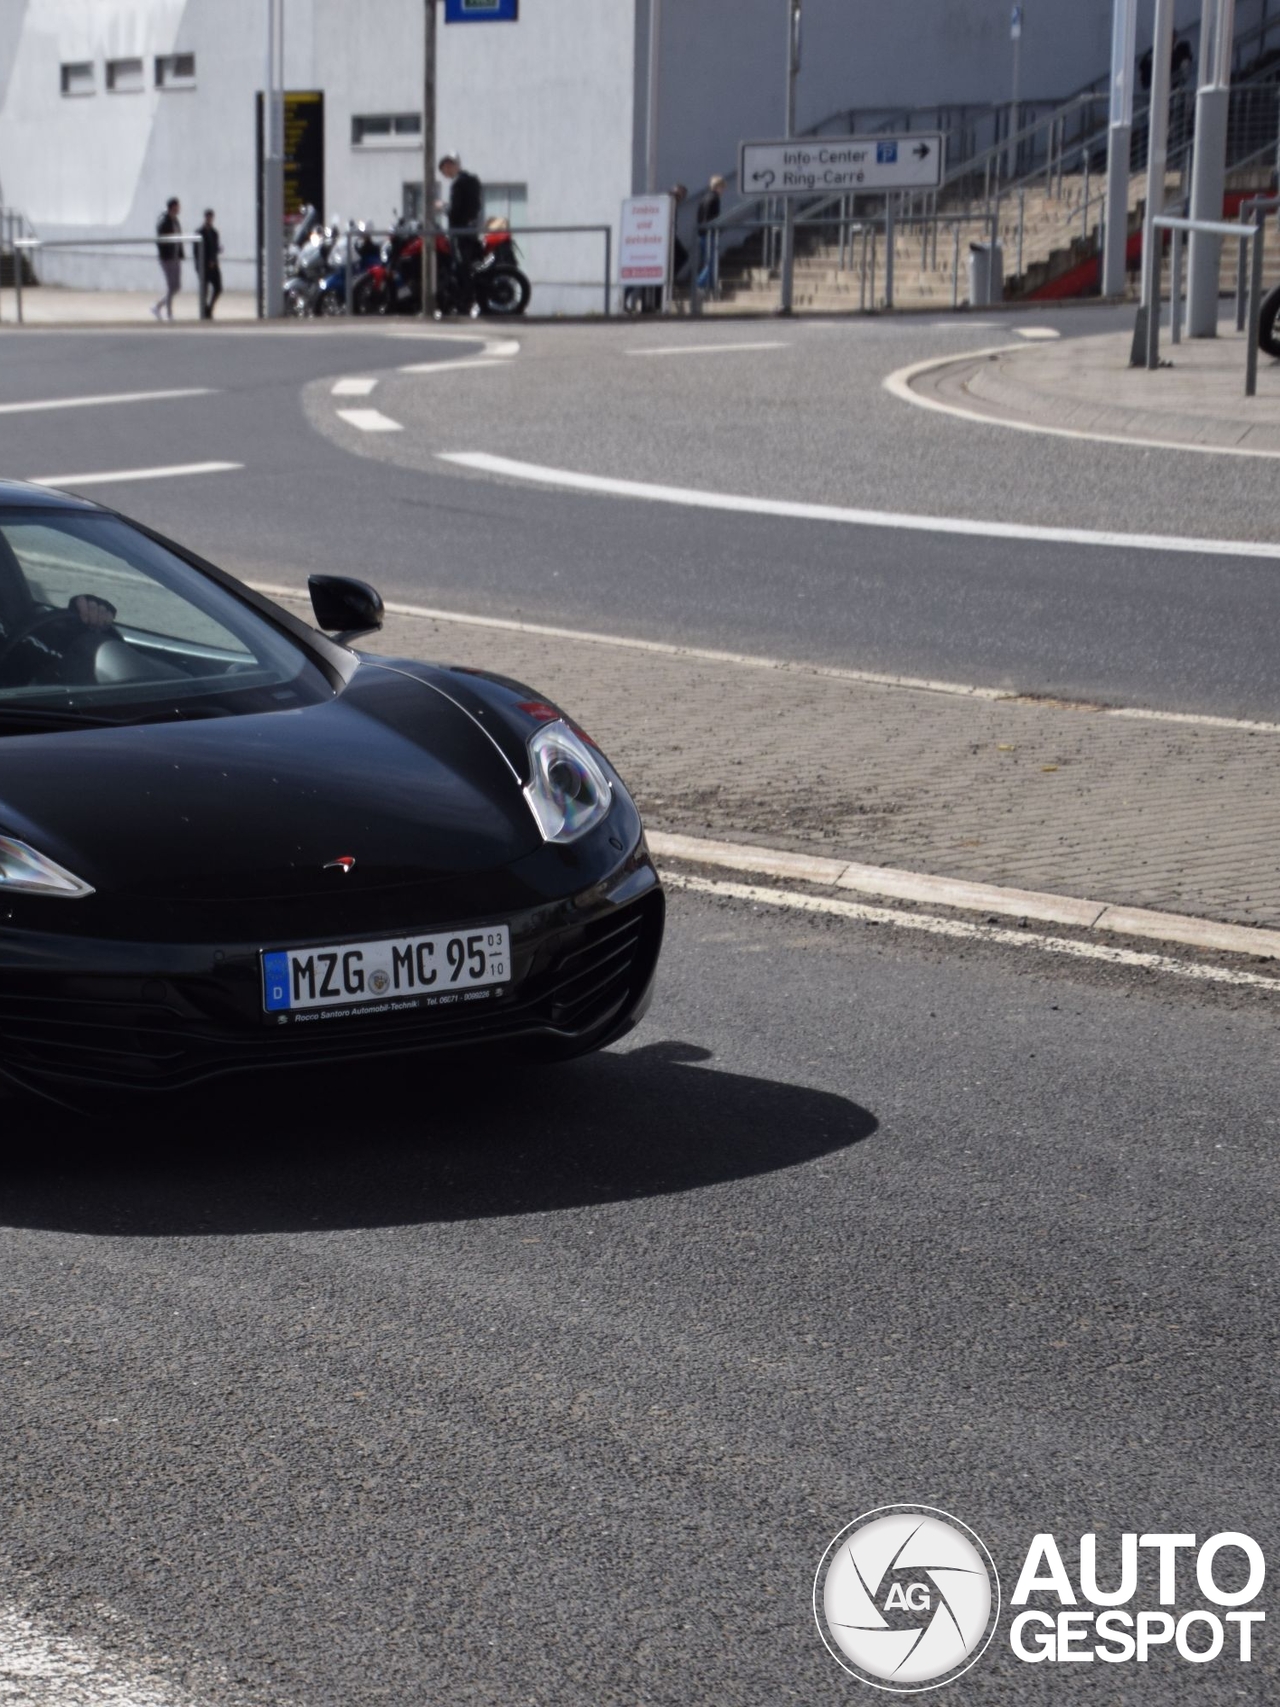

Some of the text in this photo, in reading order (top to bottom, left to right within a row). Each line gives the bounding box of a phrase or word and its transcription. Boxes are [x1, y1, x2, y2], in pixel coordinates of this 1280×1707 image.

[784, 149, 869, 165] Info-Center
[783, 169, 865, 188] Ring-Carré
[487, 933, 503, 947] 03
[292, 935, 487, 1000] MZG MC 95
[490, 963, 504, 976] 10
[273, 987, 283, 1000] D
[295, 1012, 319, 1022] Rocco
[320, 1007, 350, 1019] Santoro
